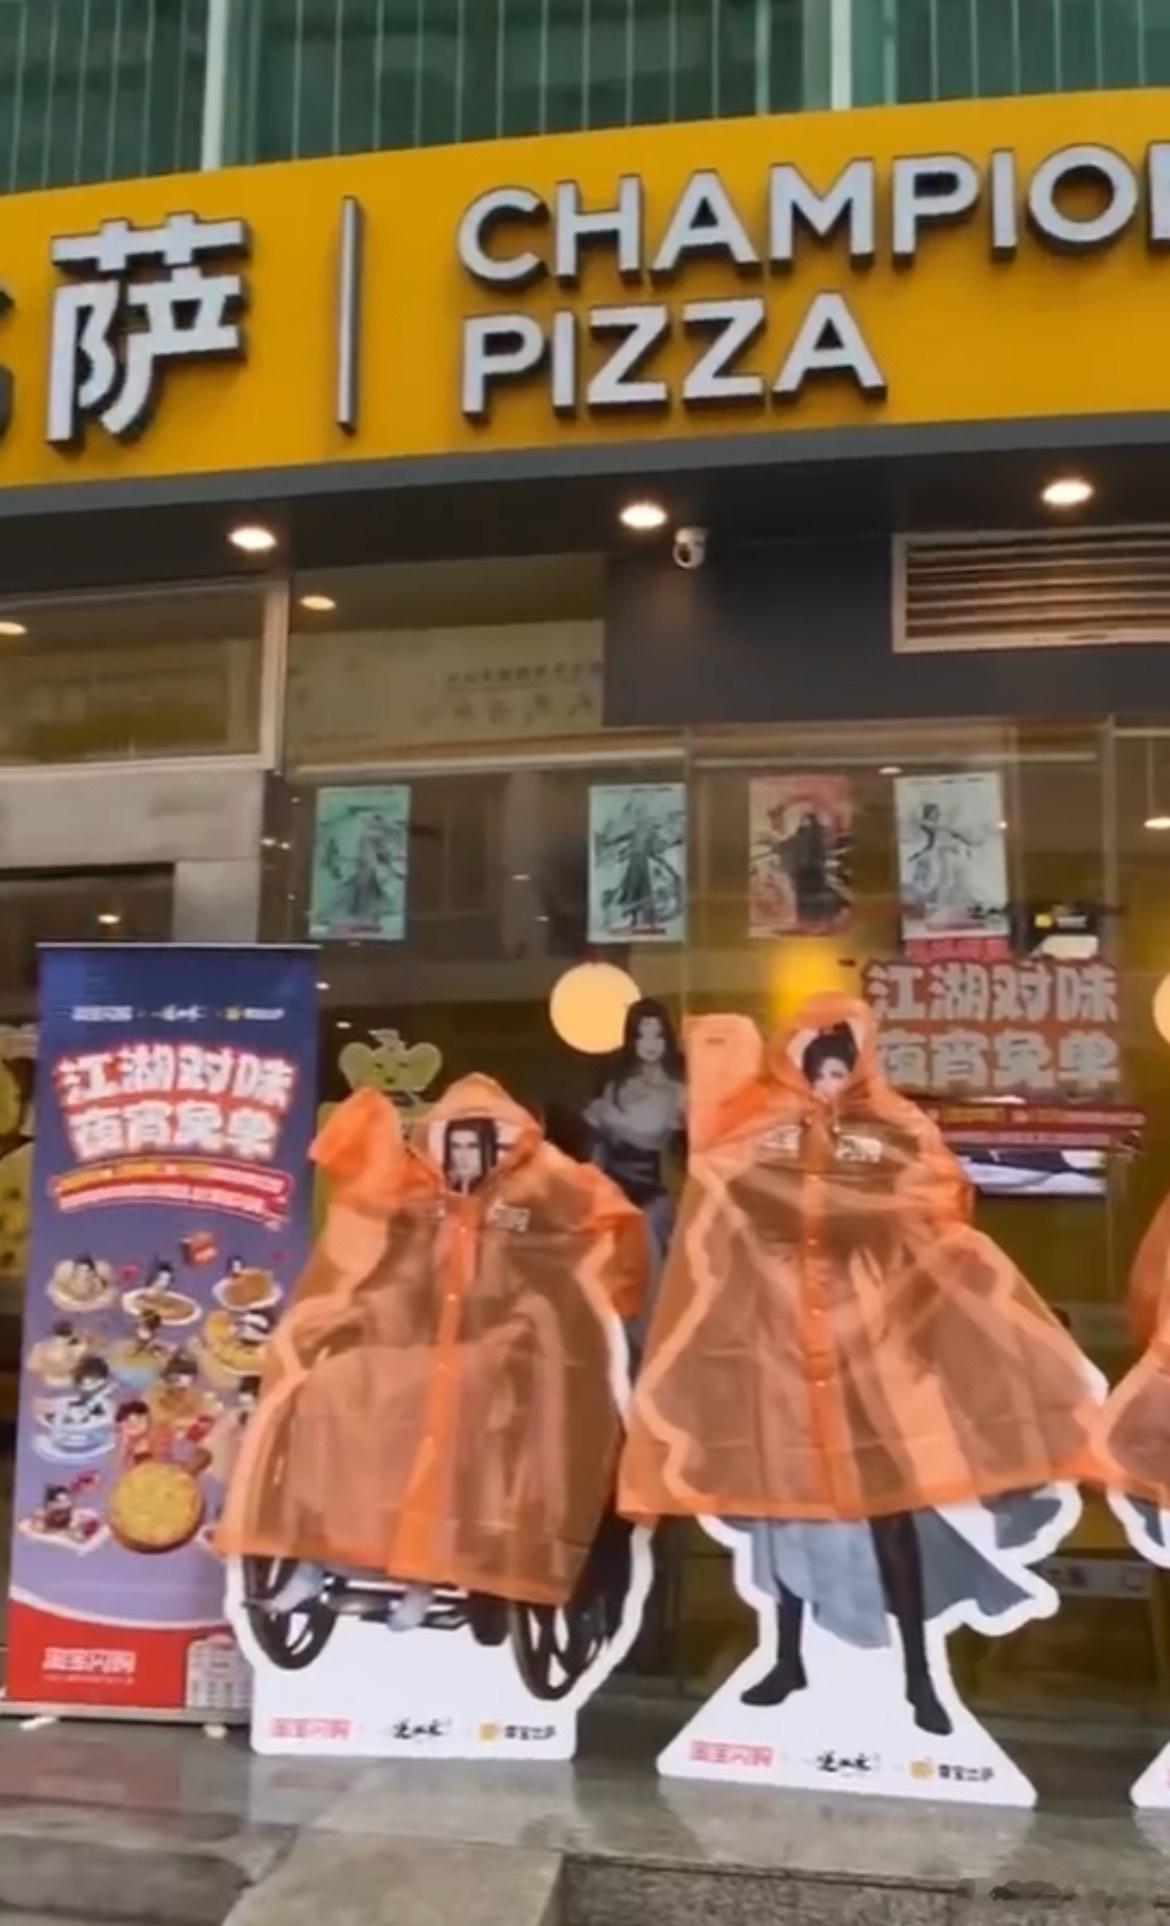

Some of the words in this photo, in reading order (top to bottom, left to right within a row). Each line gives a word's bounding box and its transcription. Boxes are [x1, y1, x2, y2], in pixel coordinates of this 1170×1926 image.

[458, 143, 1170, 283] CHAMPIO
[0, 211, 246, 443] 萨
[463, 290, 886, 419] PIZZA
[866, 961, 1119, 1022] 江湖对味
[57, 1043, 294, 1108] 江湖对味
